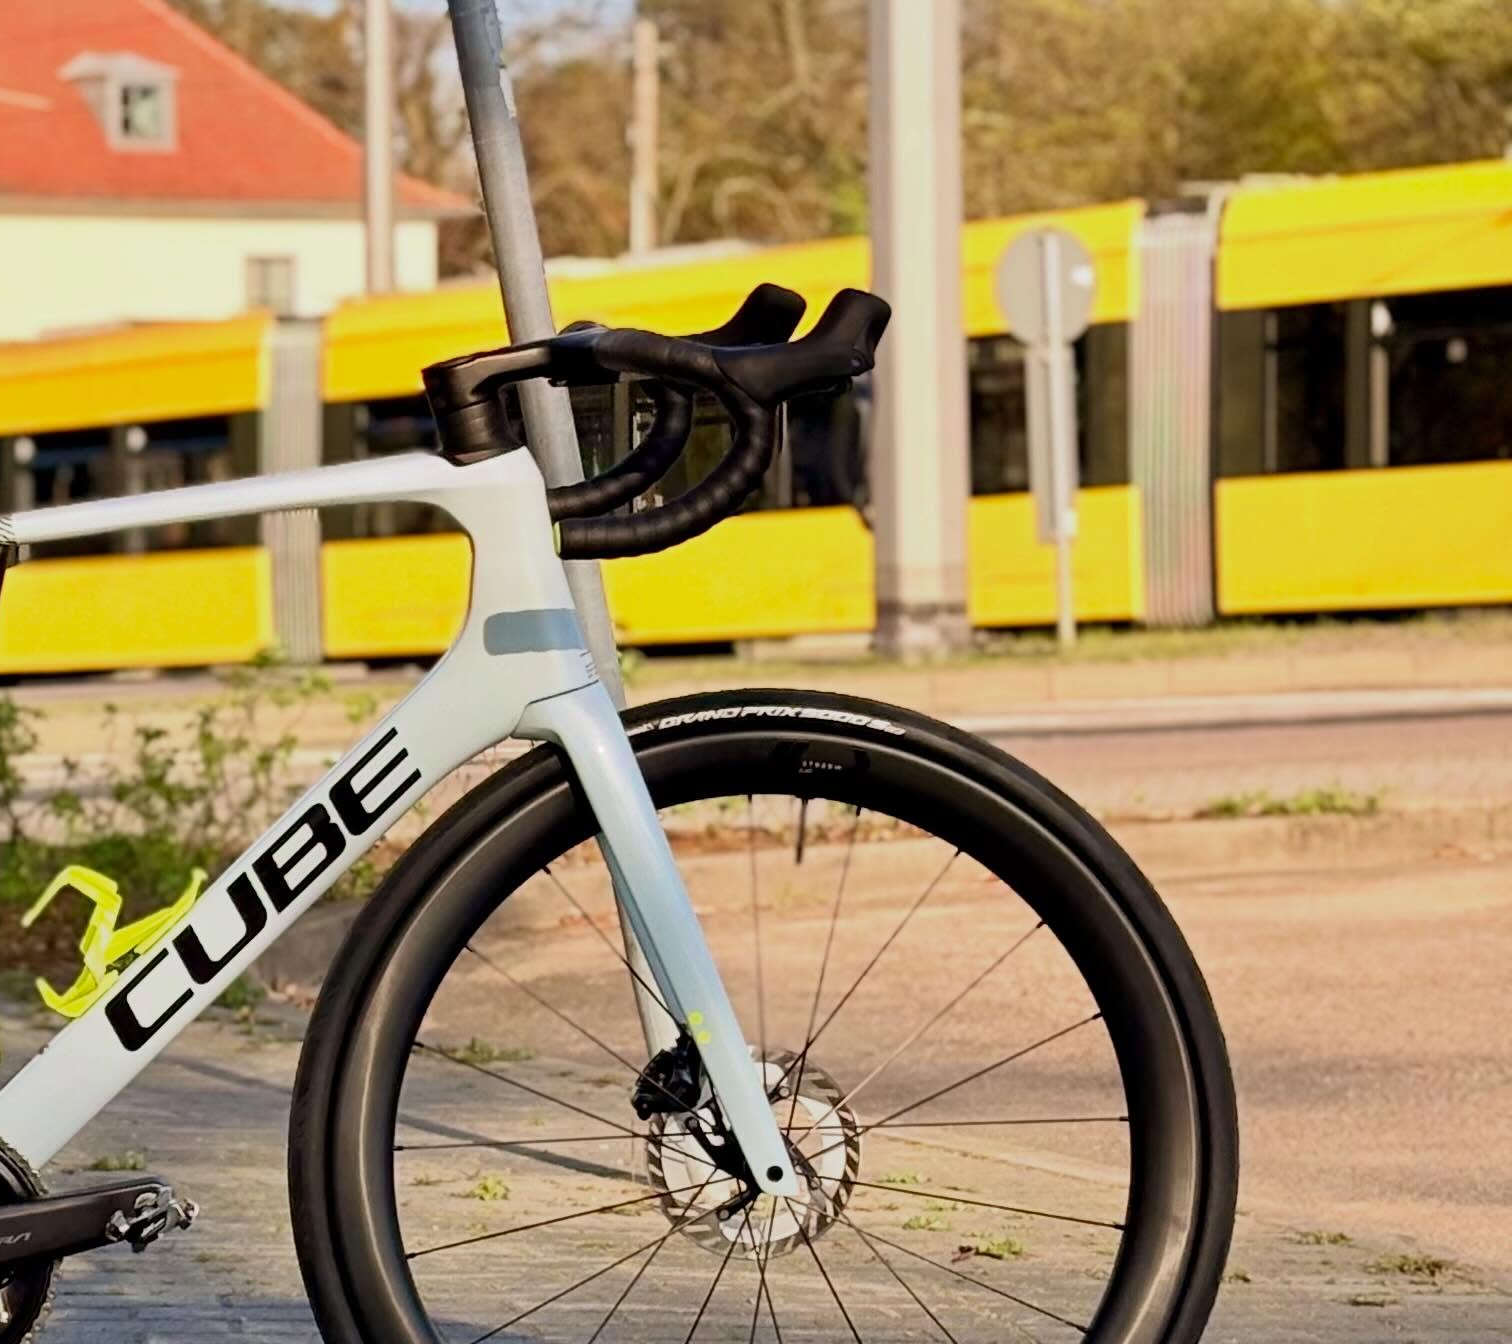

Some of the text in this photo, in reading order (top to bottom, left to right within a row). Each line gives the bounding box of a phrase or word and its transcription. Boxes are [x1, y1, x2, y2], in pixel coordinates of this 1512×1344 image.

[658, 706, 743, 730] GRAND
[740, 705, 802, 718] PRIX
[104, 727, 422, 1053] CUBE
